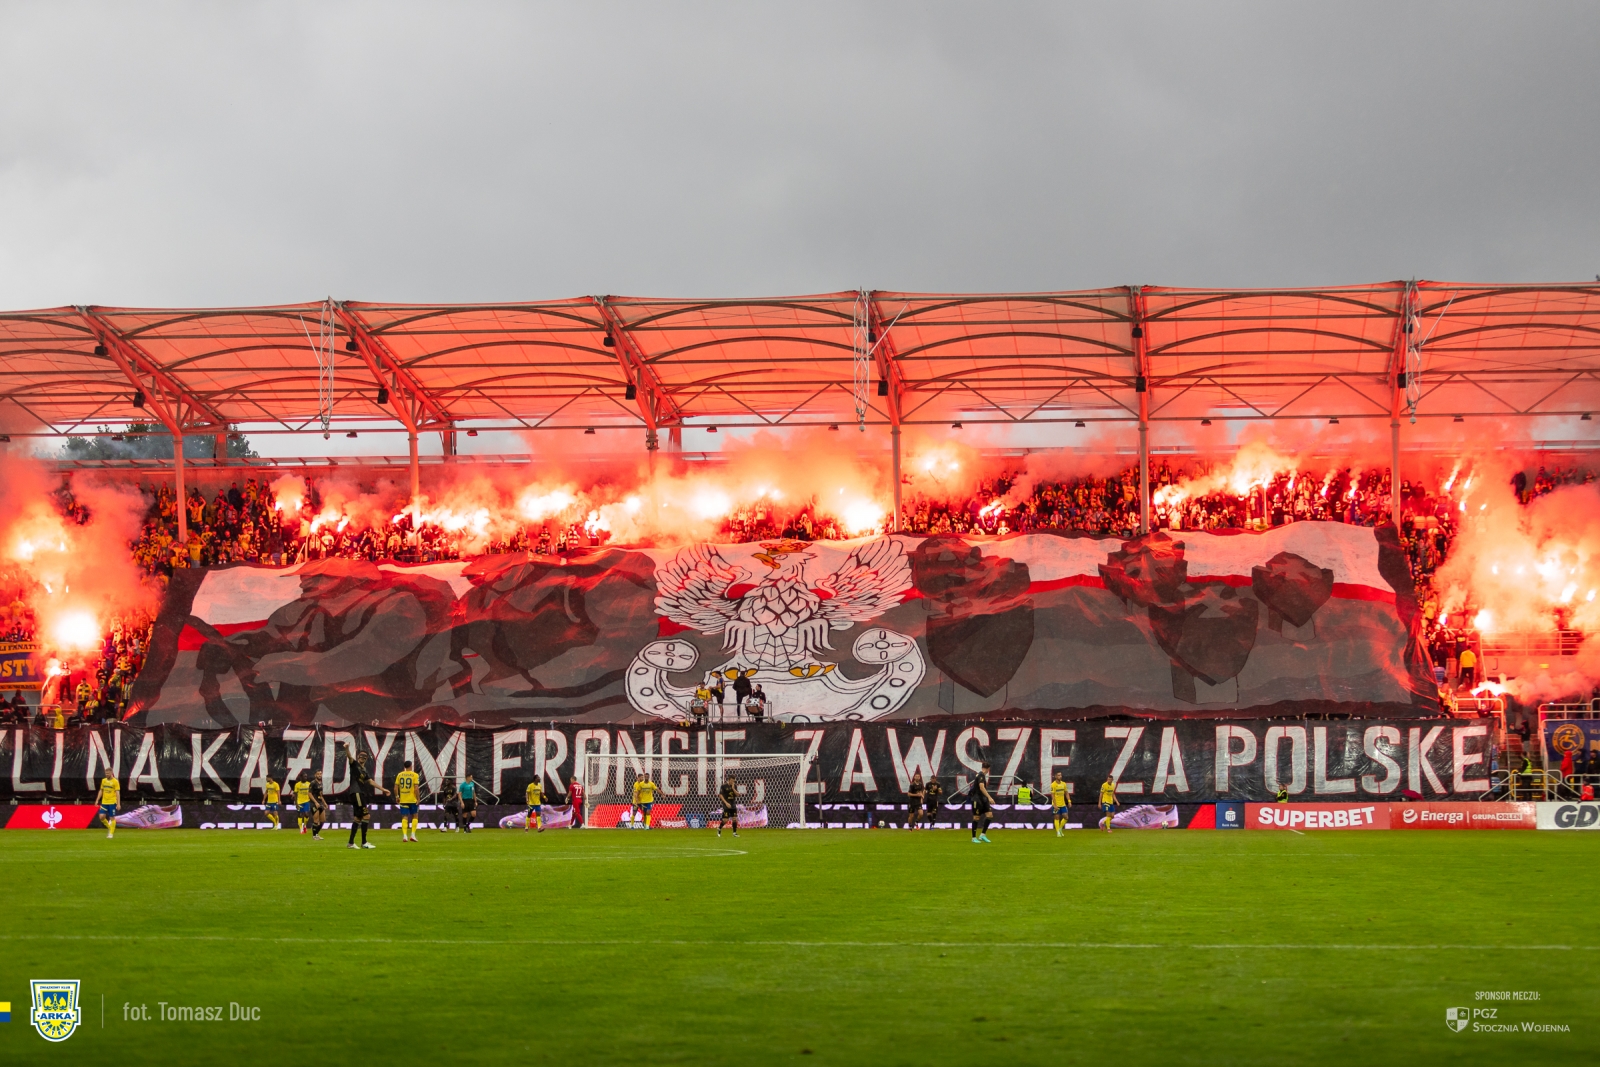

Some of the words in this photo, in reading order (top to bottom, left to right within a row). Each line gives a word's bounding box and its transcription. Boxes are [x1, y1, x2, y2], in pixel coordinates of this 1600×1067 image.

[0, 658, 37, 677] STY
[86, 728, 165, 792] NA
[792, 726, 1076, 796] ZAWSZE
[1104, 726, 1190, 794] ZA
[400, 778, 412, 789] 99
[575, 786, 583, 795] 77
[1258, 806, 1375, 828] SUPERBET
[1421, 811, 1464, 824] Energa
[1554, 805, 1600, 829] GD
